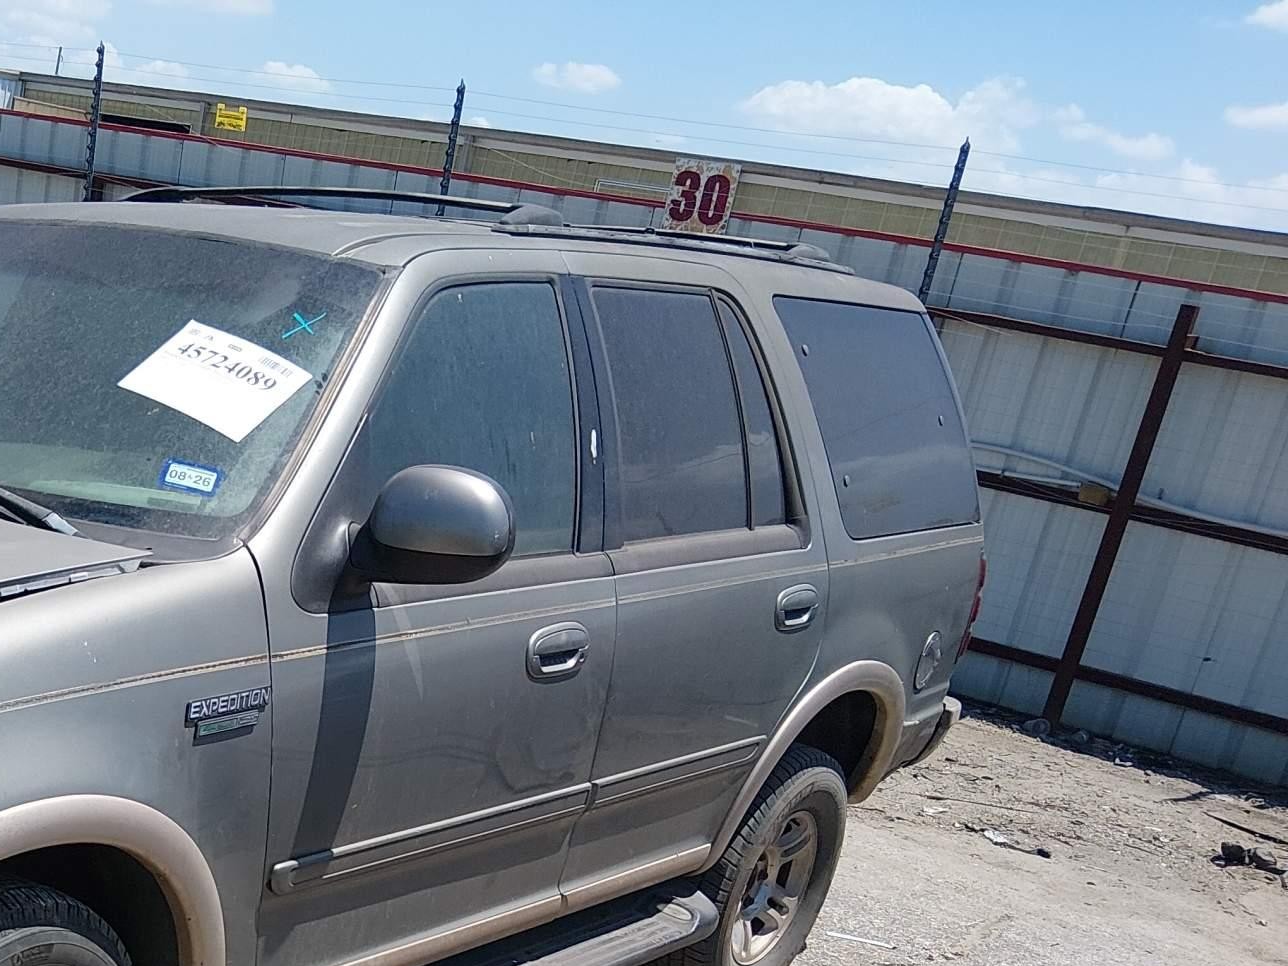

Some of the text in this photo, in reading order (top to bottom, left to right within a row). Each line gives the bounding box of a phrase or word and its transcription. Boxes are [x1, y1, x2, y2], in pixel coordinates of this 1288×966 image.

[669, 170, 730, 225] 30
[177, 343, 277, 390] 45724089
[189, 687, 271, 719] EXPEDITION
